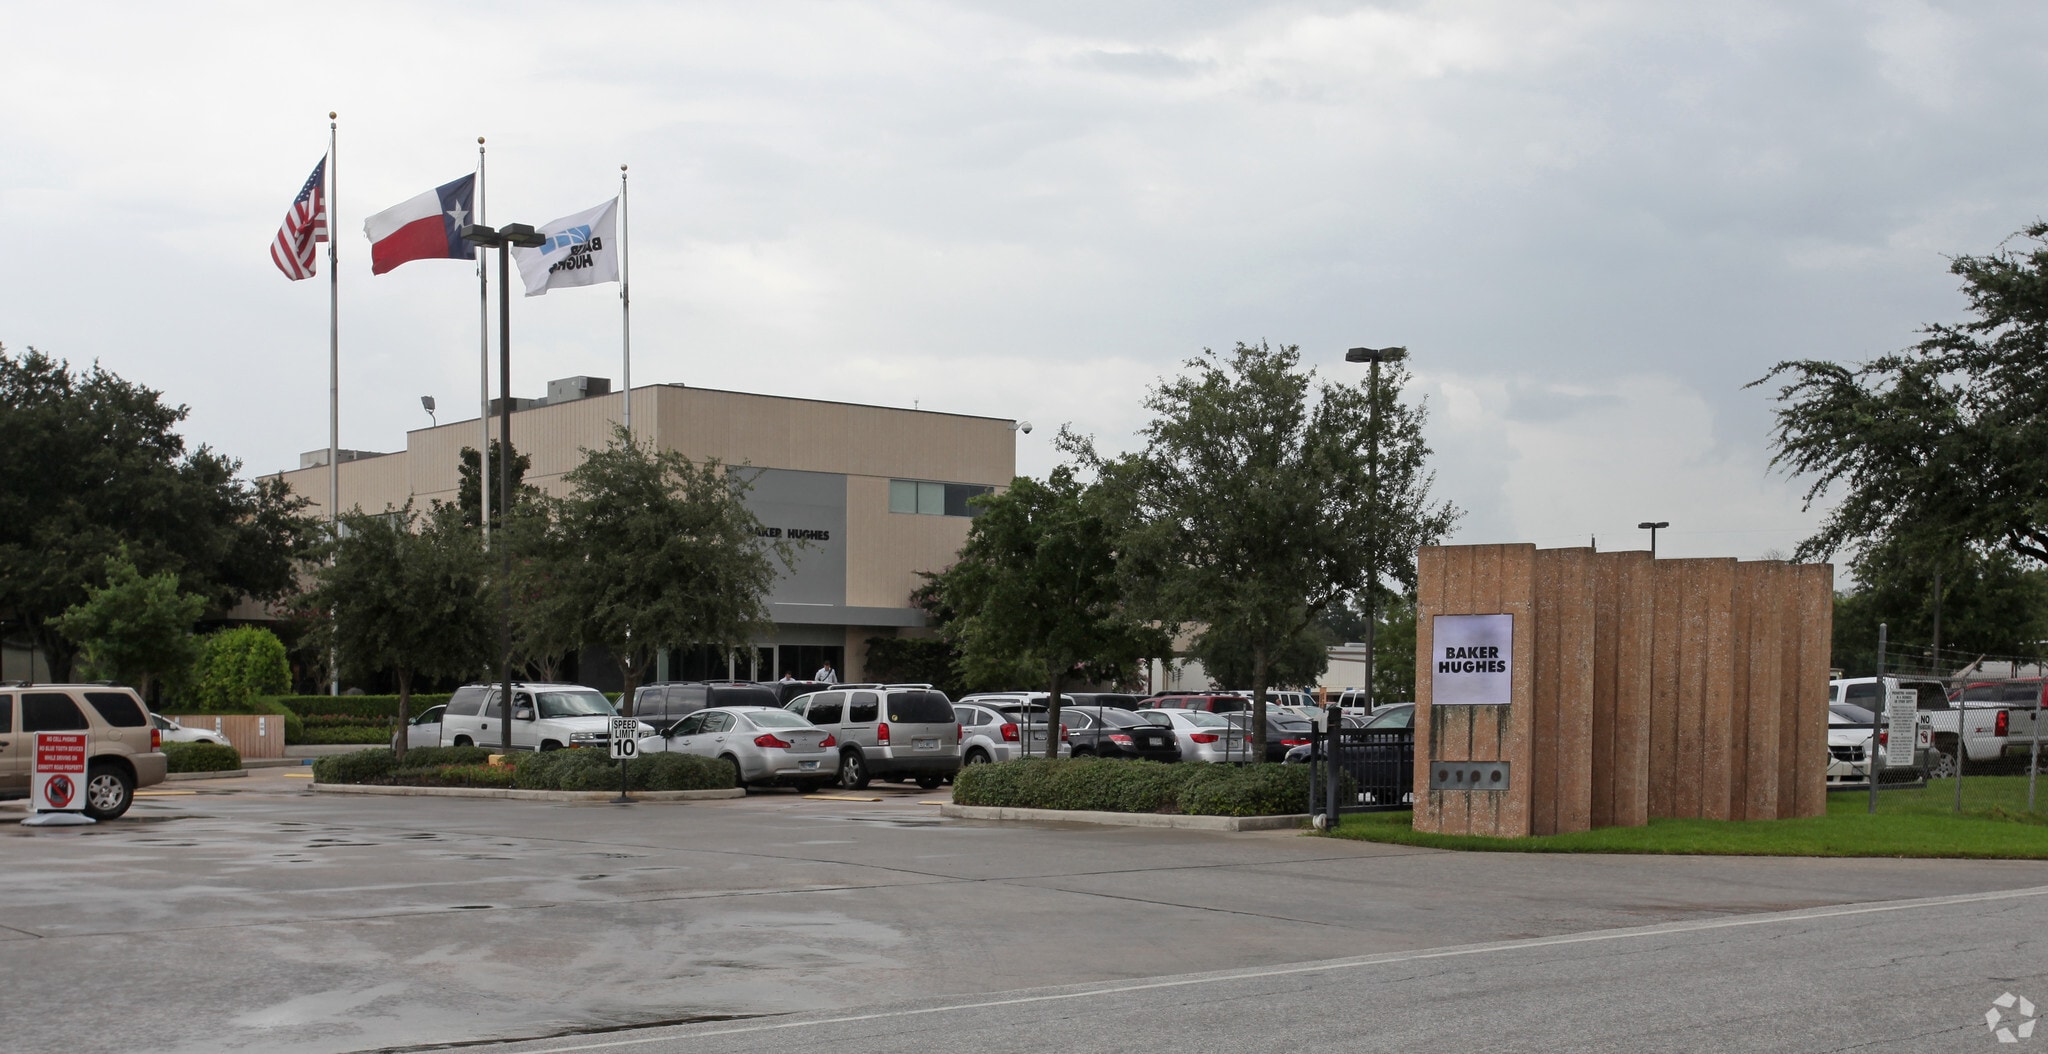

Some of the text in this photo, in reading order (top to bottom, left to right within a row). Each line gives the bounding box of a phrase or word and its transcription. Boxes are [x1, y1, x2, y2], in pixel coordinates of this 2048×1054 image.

[748, 525, 830, 541] AKER HUGHES
[1445, 647, 1499, 659] BAKER
[1438, 660, 1506, 673] HUGHES
[613, 720, 637, 729] SPEED
[1920, 715, 1930, 724] NO
[615, 730, 635, 739] LIMIT
[614, 739, 635, 756] 10
